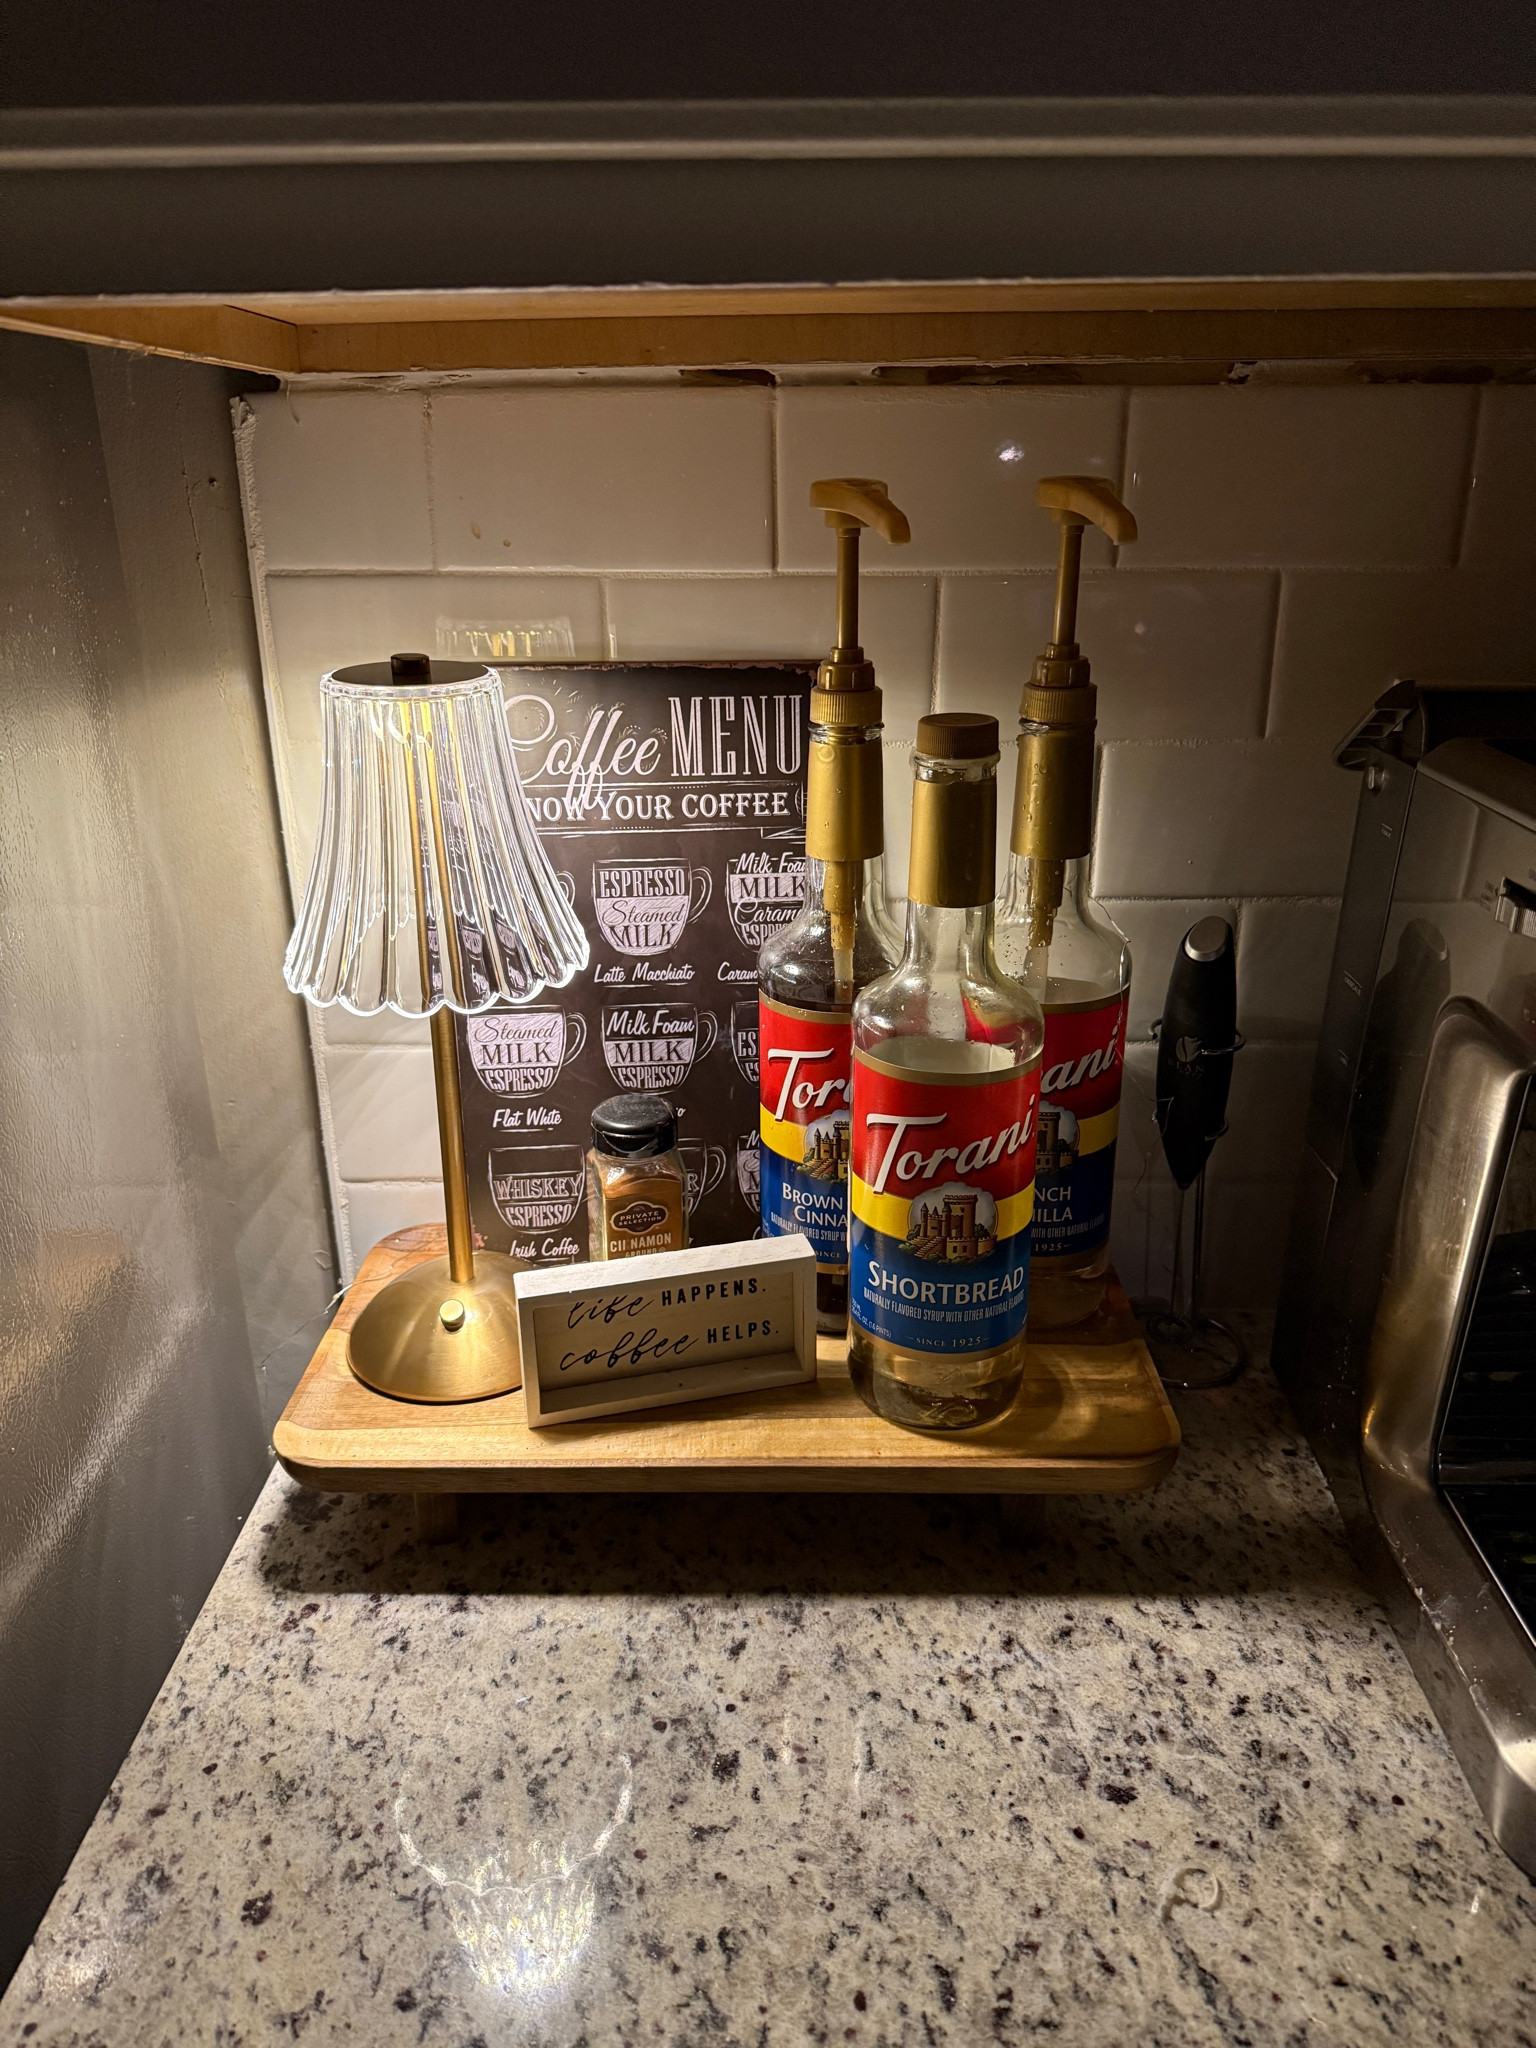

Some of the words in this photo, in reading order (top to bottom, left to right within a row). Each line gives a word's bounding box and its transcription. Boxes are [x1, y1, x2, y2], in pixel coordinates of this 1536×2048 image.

[504, 695, 661, 810] Coffee
[668, 695, 802, 777] MENU
[526, 796, 586, 822] NOW
[595, 791, 674, 821] YOUR
[681, 793, 791, 819] COFFEE
[736, 851, 773, 875] Milk
[600, 869, 685, 898] ESPRESSO
[739, 875, 806, 899] MILK
[602, 900, 686, 926] Steamed
[734, 897, 803, 926] Caram
[607, 922, 678, 948] MILK
[593, 962, 626, 983] Latte
[631, 961, 696, 982] Macchiato
[717, 961, 759, 981] Caram
[474, 1016, 558, 1043] Steamed
[606, 1009, 650, 1036] Milk
[651, 1009, 695, 1035] Foam
[481, 1041, 557, 1065] MILK
[613, 1040, 687, 1065] MILK
[1040, 1024, 1119, 1094] ani
[484, 1067, 554, 1091] ESPRESSO
[617, 1065, 685, 1089] ESPRESSO
[767, 1047, 850, 1121] Tor
[492, 1108, 524, 1128] Flat
[526, 1106, 562, 1126] White
[865, 1093, 1036, 1195] Torani
[493, 1172, 583, 1200] WHISKEY
[782, 1182, 843, 1211] BROWN
[1034, 1185, 1072, 1202] NCH
[504, 1203, 573, 1228] ESPRESSO
[618, 1215, 662, 1226] SELECTION
[620, 1210, 660, 1221] PRIVATE
[794, 1205, 848, 1227] CINNA
[1031, 1206, 1073, 1223] ILLA
[509, 1239, 537, 1258] Irish
[541, 1237, 580, 1257] Coffee
[820, 1229, 839, 1242] SYRUP
[1035, 1242, 1062, 1252] 1925
[661, 1277, 767, 1306] HAPPENS.
[868, 1260, 1025, 1306] SHORTBREAD
[863, 1286, 891, 1310] NATURALLY
[891, 1300, 922, 1319] FLAVORED
[923, 1308, 945, 1322] SYRUP
[945, 1311, 963, 1323] WITH
[964, 1308, 984, 1322] OTHER
[984, 1301, 1009, 1319] NATURAL
[559, 1328, 699, 1371] coffee
[707, 1319, 779, 1344] HELPS.
[916, 1337, 946, 1347] SINCE
[952, 1336, 982, 1348] 1925
